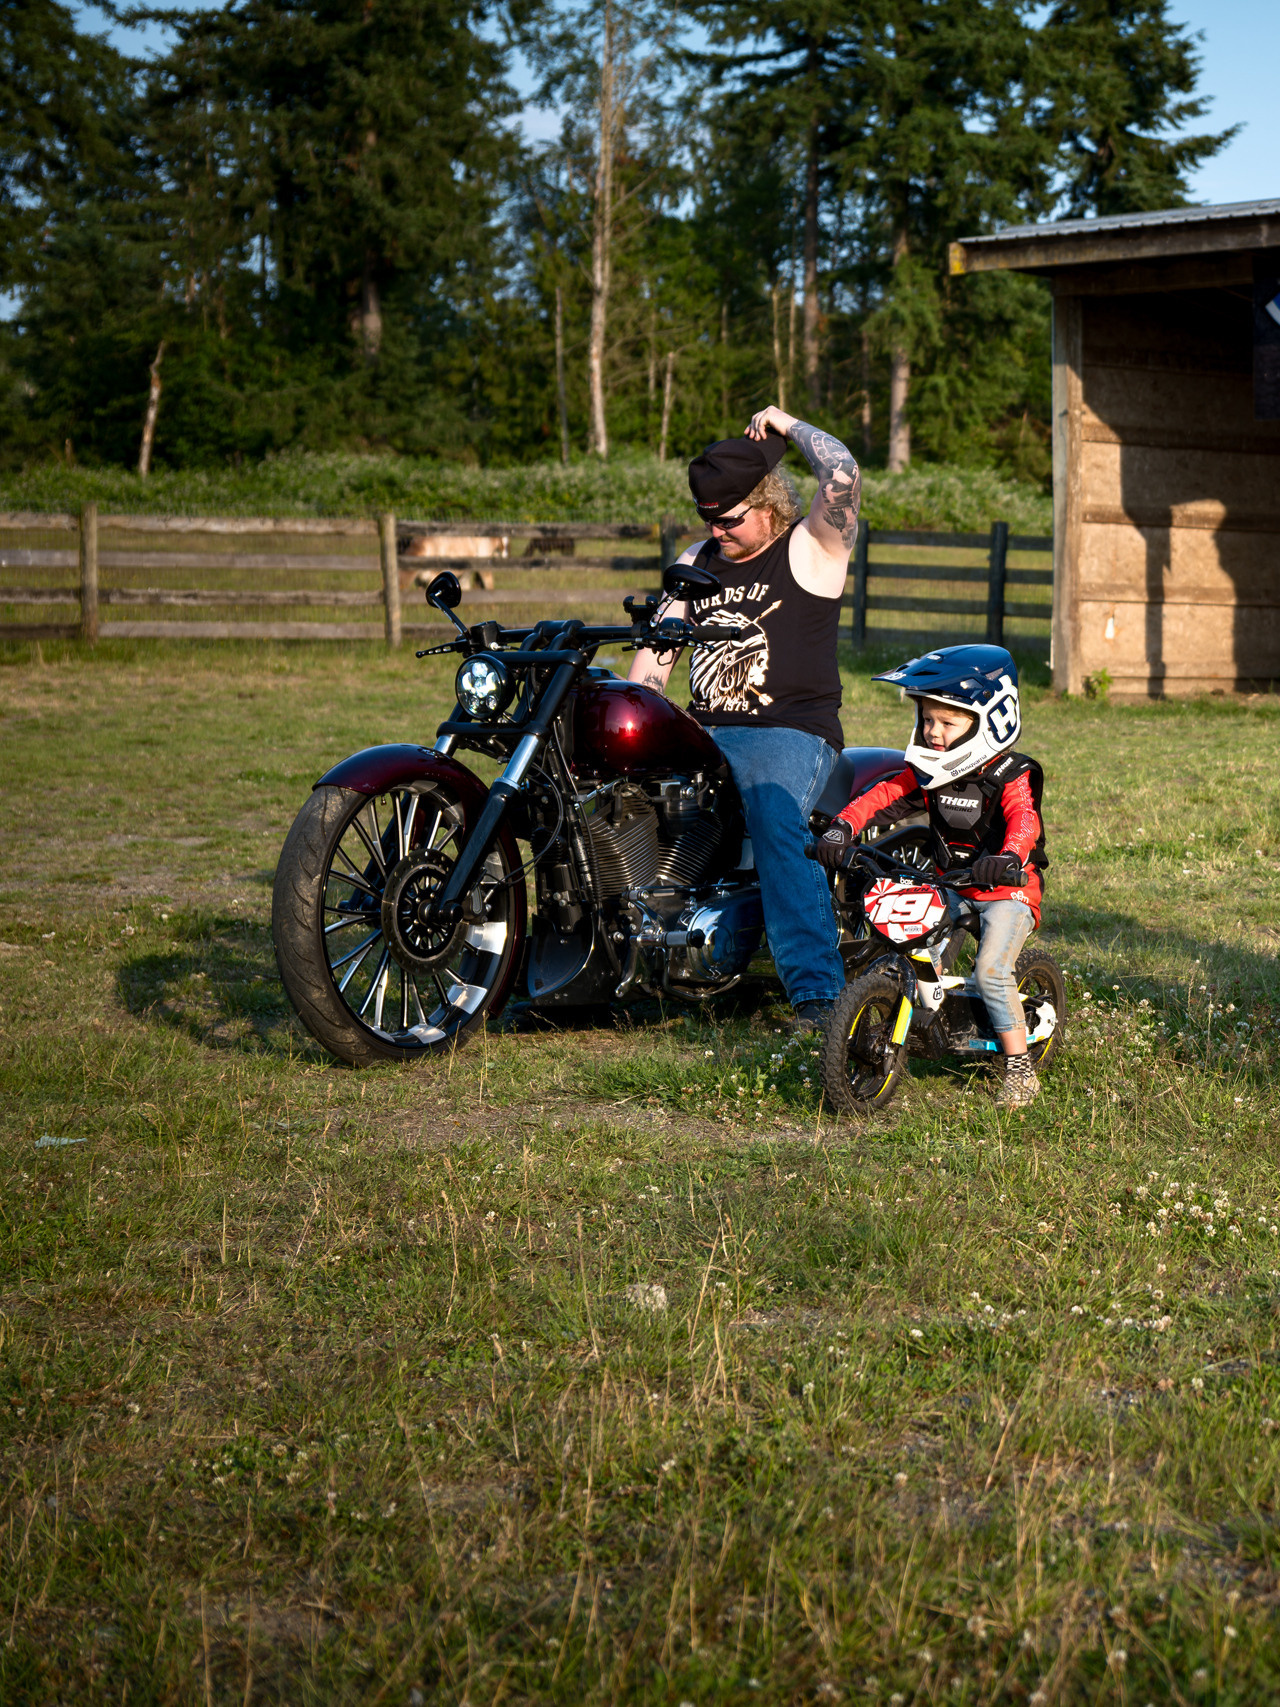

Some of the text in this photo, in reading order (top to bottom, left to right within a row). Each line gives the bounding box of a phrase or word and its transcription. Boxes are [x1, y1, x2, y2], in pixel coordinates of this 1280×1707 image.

[746, 582, 770, 602] OF
[722, 700, 749, 711] 1979
[958, 754, 988, 774] Husqvarna
[994, 756, 1014, 777] THOR
[939, 794, 980, 809] THOR
[944, 805, 973, 813] RACING
[873, 892, 934, 925] 19
